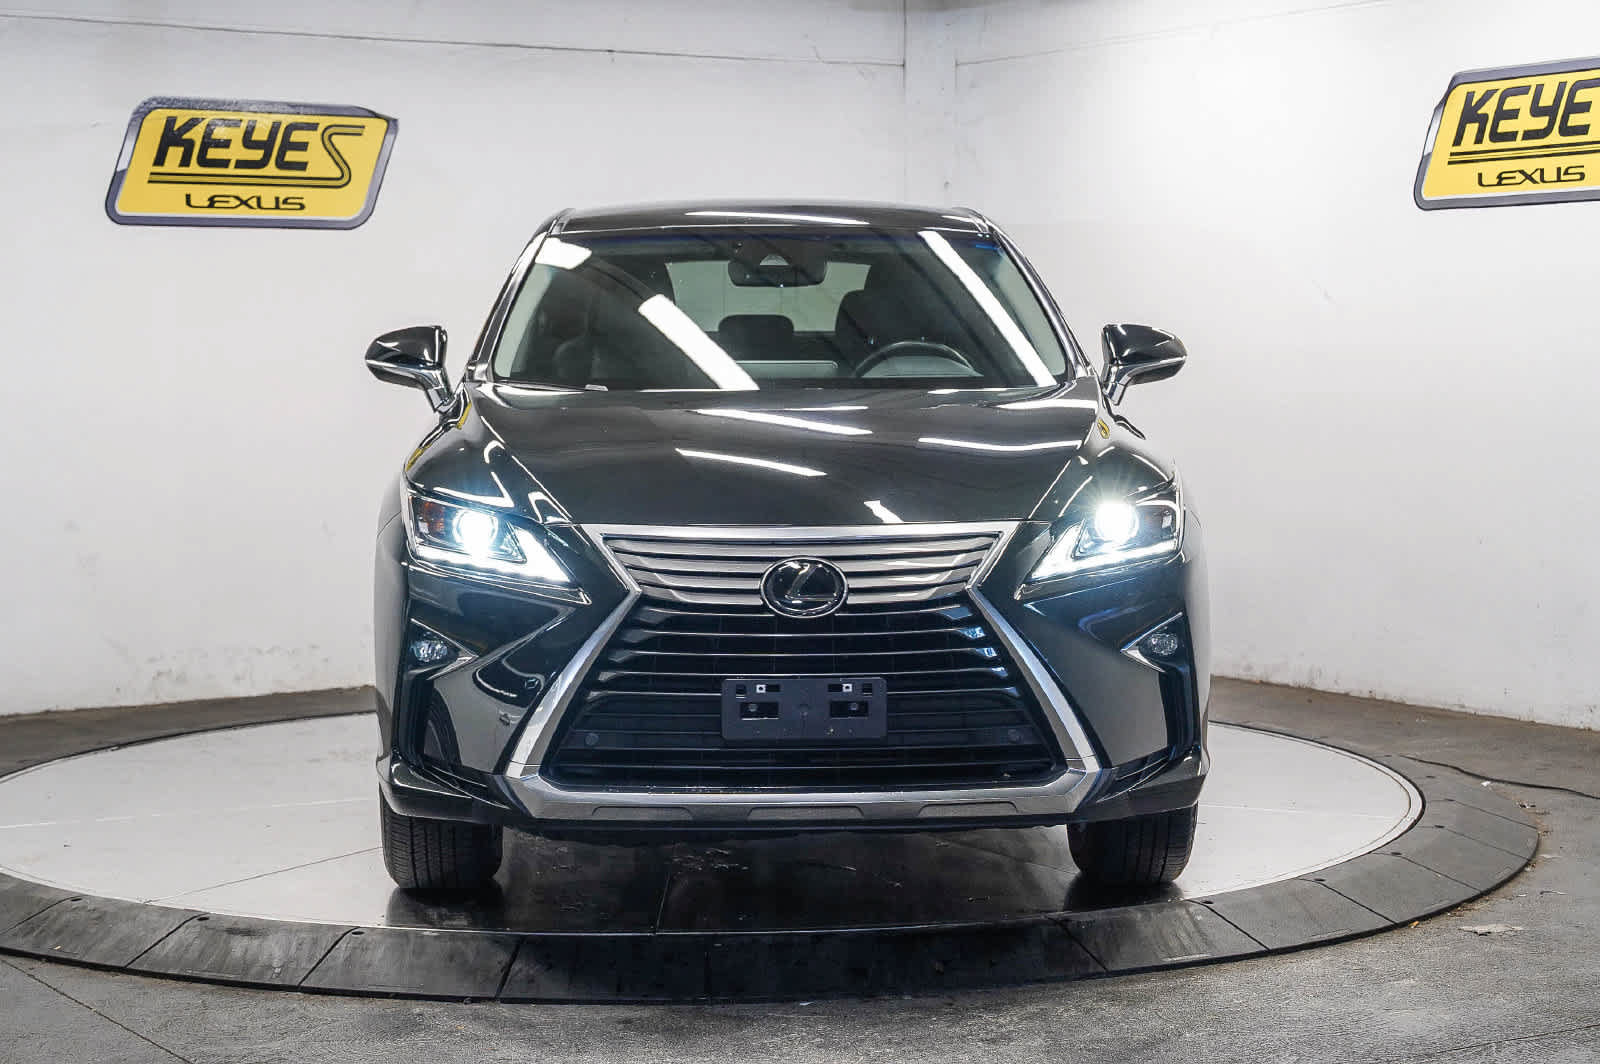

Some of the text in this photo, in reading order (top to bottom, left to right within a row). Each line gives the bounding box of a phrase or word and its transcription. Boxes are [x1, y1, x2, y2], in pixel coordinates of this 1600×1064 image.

[1452, 78, 1600, 147] KEYE
[150, 116, 365, 189] KEYES
[1477, 165, 1586, 188] LEXUS
[185, 193, 306, 211] LEXUS
